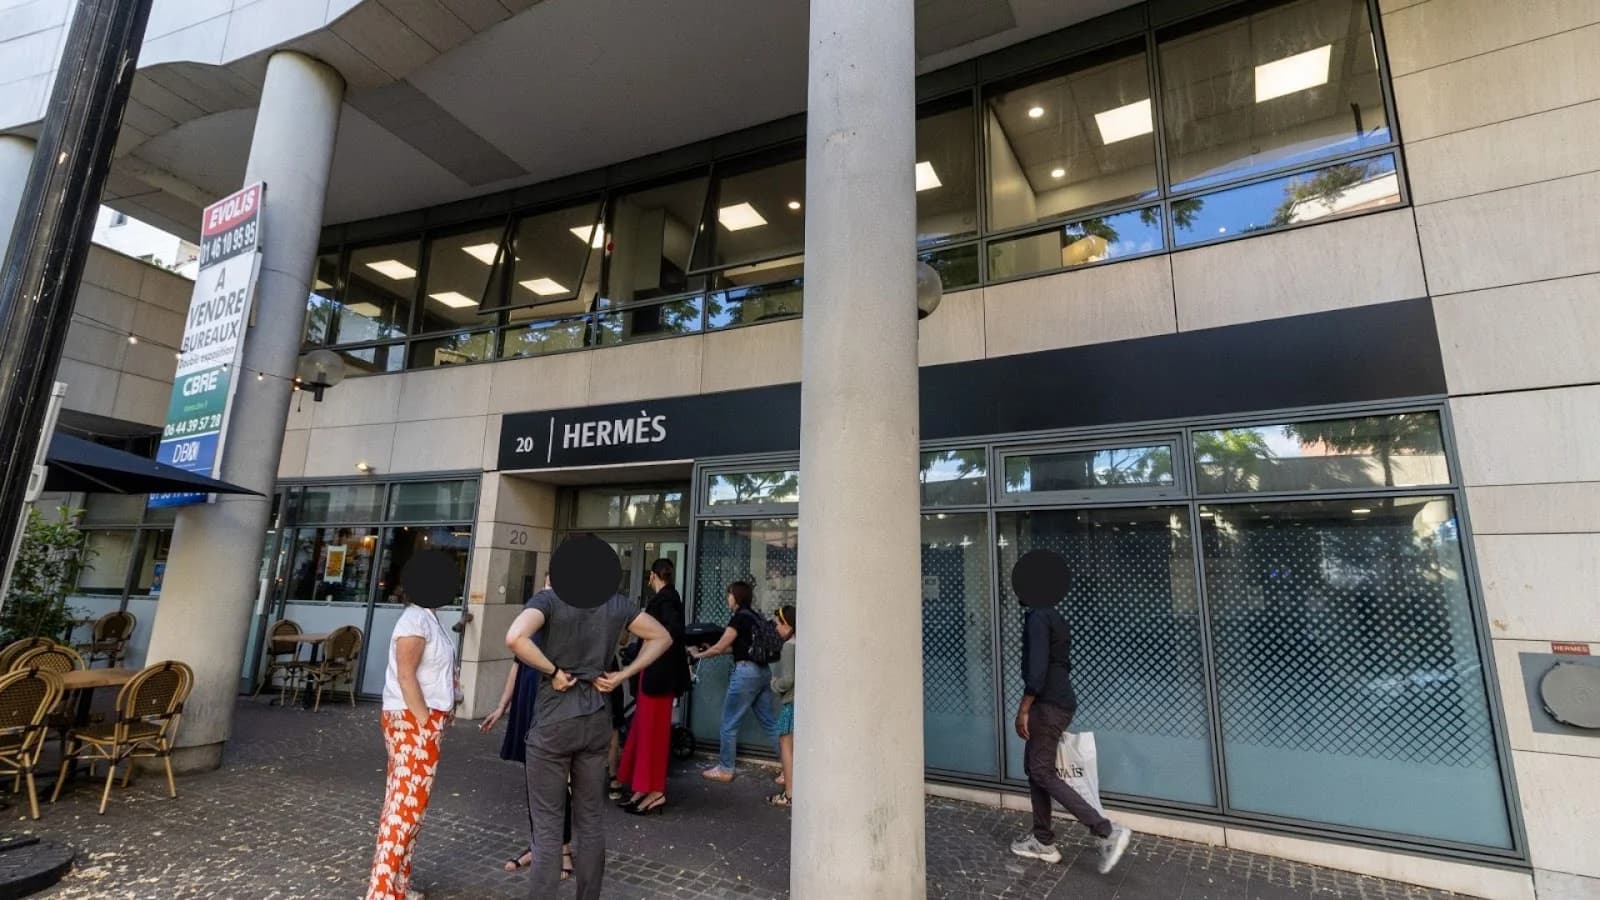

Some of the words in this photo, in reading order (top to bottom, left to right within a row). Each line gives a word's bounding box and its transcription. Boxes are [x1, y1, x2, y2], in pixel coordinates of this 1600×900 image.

[208, 189, 256, 230] EVOLIS
[200, 241, 211, 265] 01
[211, 236, 221, 260] 46
[222, 231, 232, 255] 10
[233, 226, 244, 251] 95
[244, 221, 256, 246] 95
[214, 267, 226, 292] A
[189, 287, 246, 329] VENDRE
[182, 319, 240, 353] BUREAUX
[183, 370, 220, 396] CBRE
[164, 423, 176, 437] 06
[175, 421, 187, 434] 44
[187, 418, 198, 432] 39
[198, 415, 210, 430] 57
[515, 436, 534, 453] 20
[563, 410, 667, 449] HERMÈS
[509, 529, 529, 545] 20
